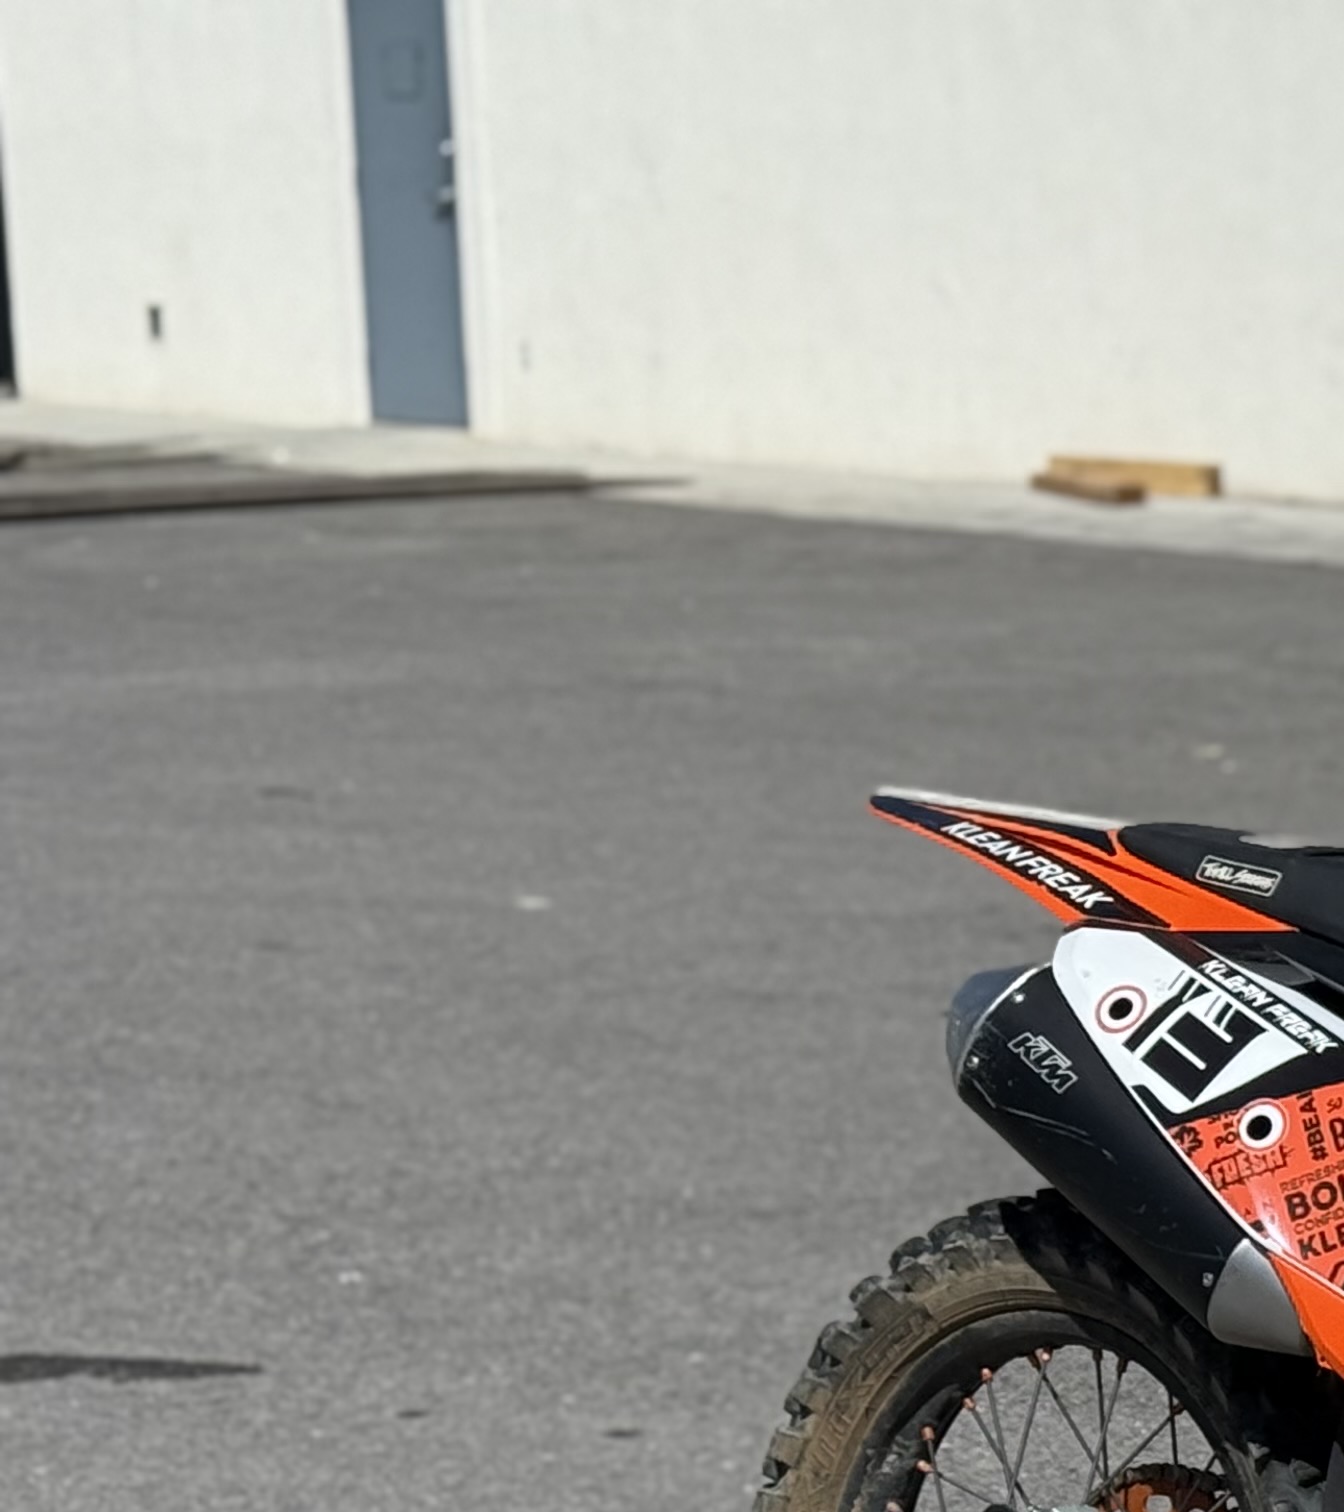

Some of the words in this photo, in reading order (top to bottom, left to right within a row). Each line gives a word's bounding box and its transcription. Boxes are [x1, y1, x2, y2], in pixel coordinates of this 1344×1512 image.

[940, 821, 1034, 867] KLEAN
[1028, 855, 1115, 910] FREAK
[1198, 958, 1274, 1008] KLEAN
[1261, 1003, 1340, 1054] FREAK
[1007, 1032, 1079, 1094] KTM
